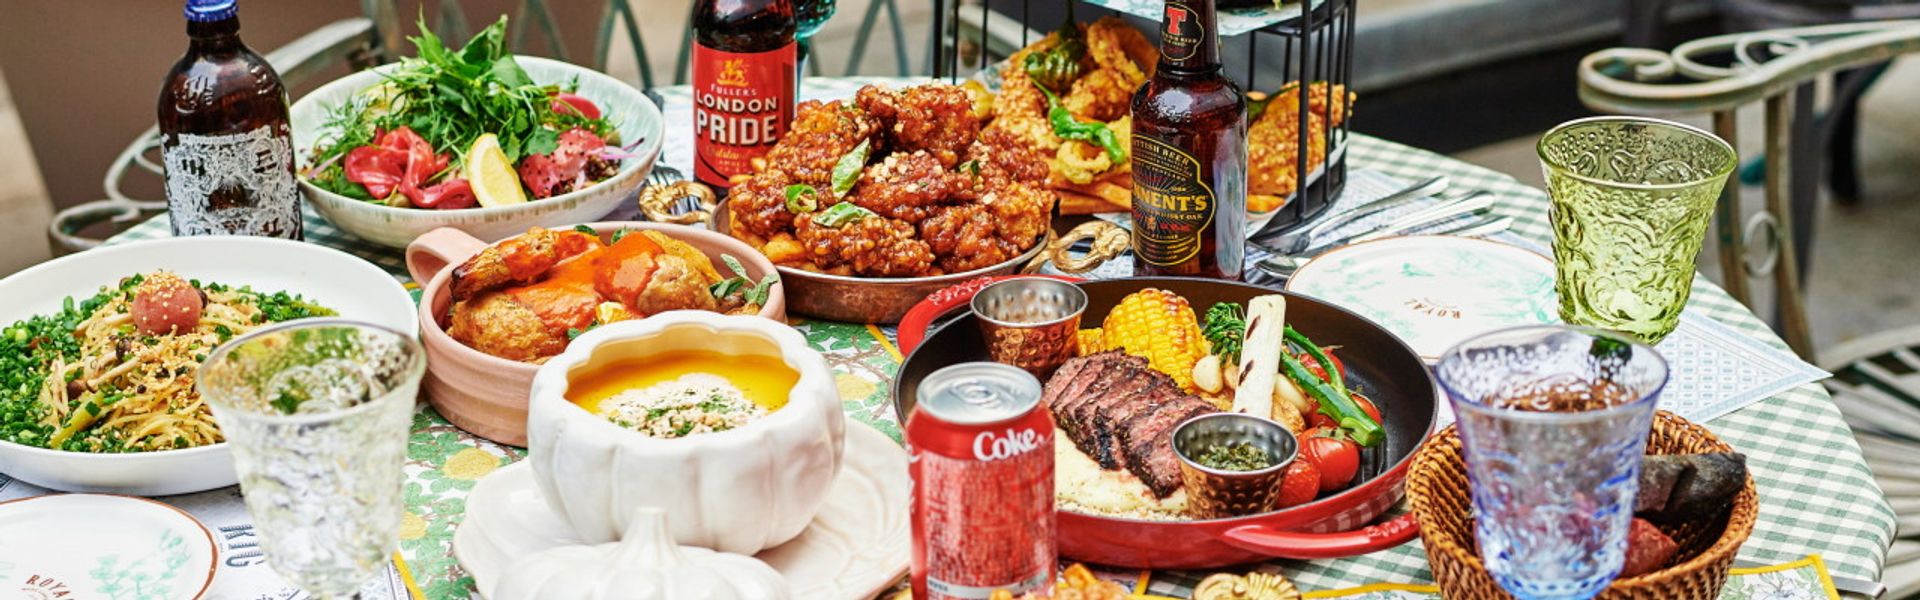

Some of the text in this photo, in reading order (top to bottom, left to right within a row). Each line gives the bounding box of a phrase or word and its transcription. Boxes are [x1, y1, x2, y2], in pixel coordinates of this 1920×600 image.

[1166, 7, 1187, 35] T
[697, 89, 777, 113] LONDON
[697, 107, 777, 146] PRIDE
[973, 428, 1039, 462] Coke
[26, 574, 74, 600] ROYA
